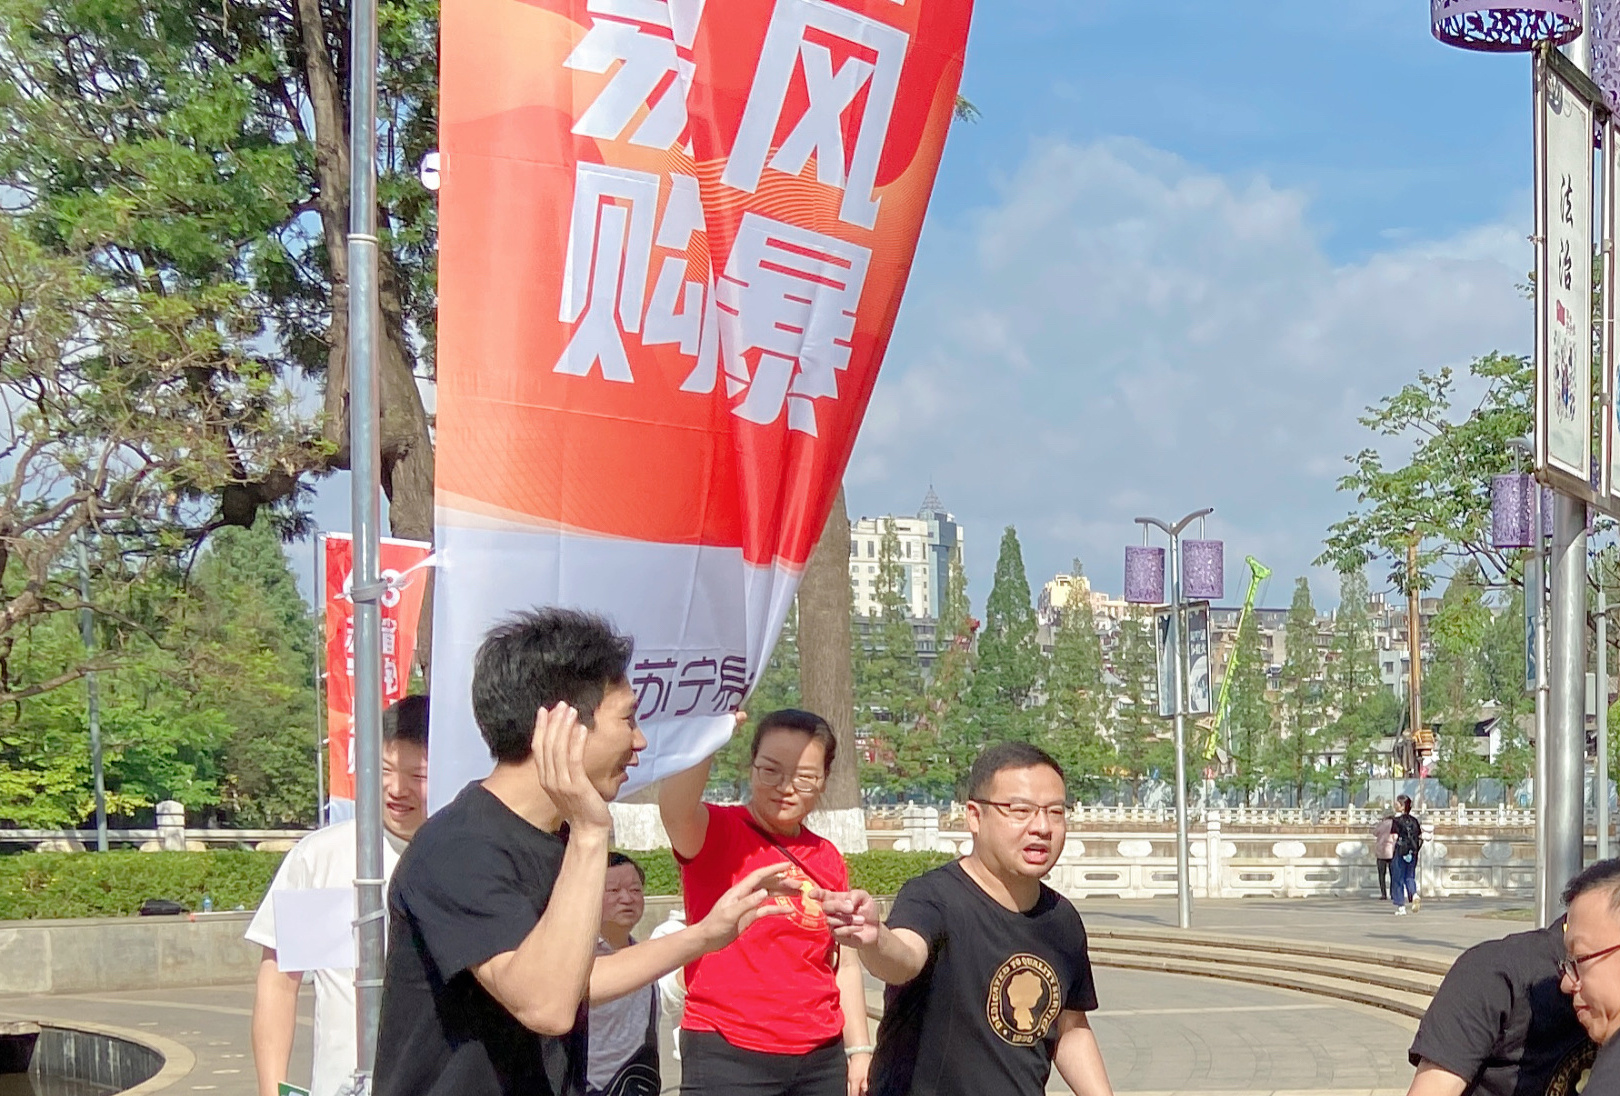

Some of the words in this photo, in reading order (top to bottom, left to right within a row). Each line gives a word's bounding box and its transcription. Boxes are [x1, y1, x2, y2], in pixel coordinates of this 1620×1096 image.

[714, 0, 910, 437] 风暴
[1558, 173, 1574, 291] 法治
[632, 655, 754, 721] 苏宁易
[991, 965, 1011, 1030] DEDICATED
[1010, 957, 1022, 969] TO
[1021, 956, 1055, 985] QUALITY
[1040, 985, 1060, 1033] SERVICE
